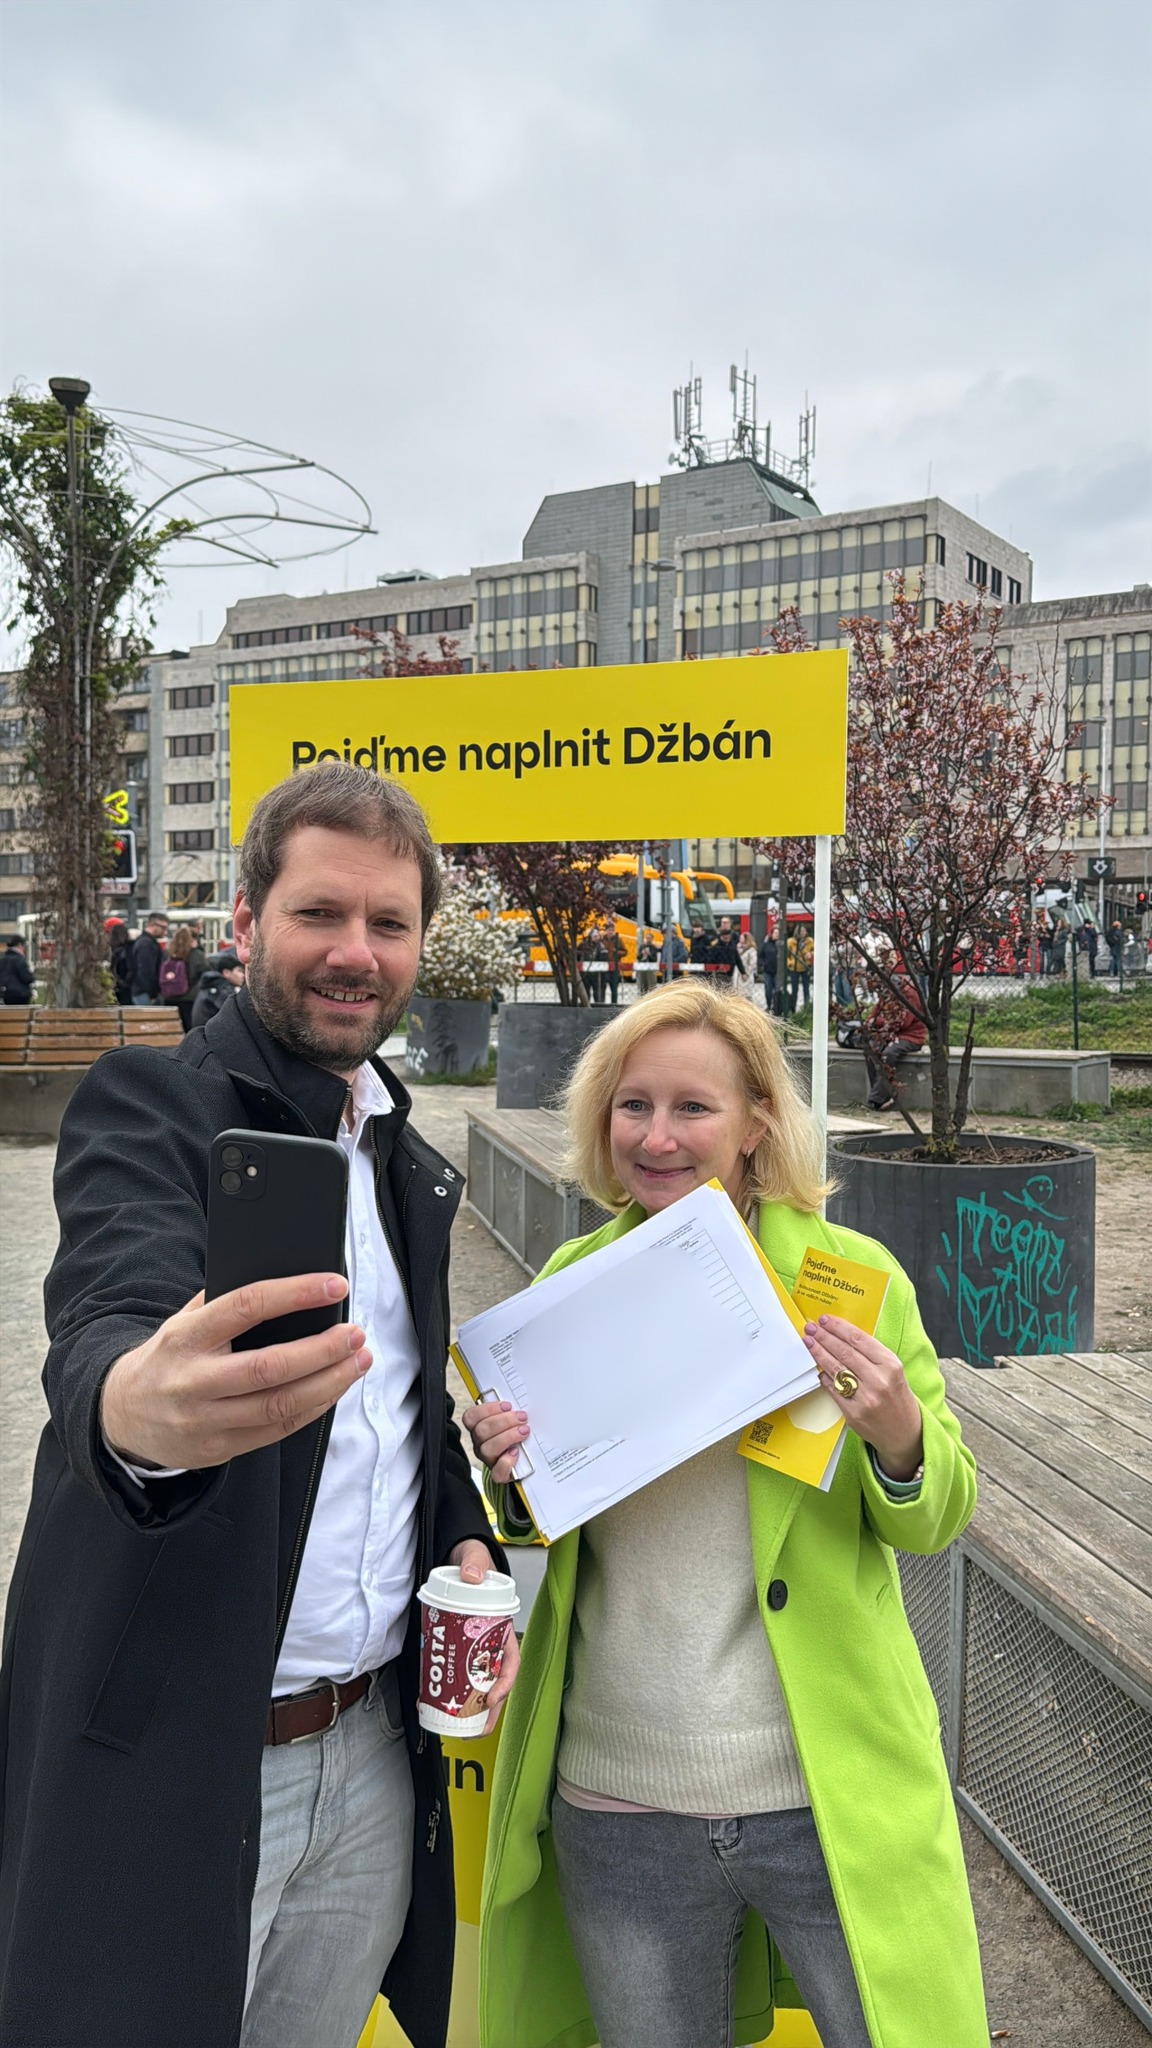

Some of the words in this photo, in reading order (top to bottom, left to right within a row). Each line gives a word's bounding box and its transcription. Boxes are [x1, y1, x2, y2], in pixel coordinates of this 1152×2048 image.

[458, 728, 611, 779] naplnit
[623, 719, 771, 765] Džbán
[802, 1269, 832, 1285] naplnit
[832, 1278, 865, 1297] Džbán
[806, 1257, 837, 1275] Pojďme
[428, 1625, 446, 1698] COSTA
[446, 1643, 456, 1684] COFFEE
